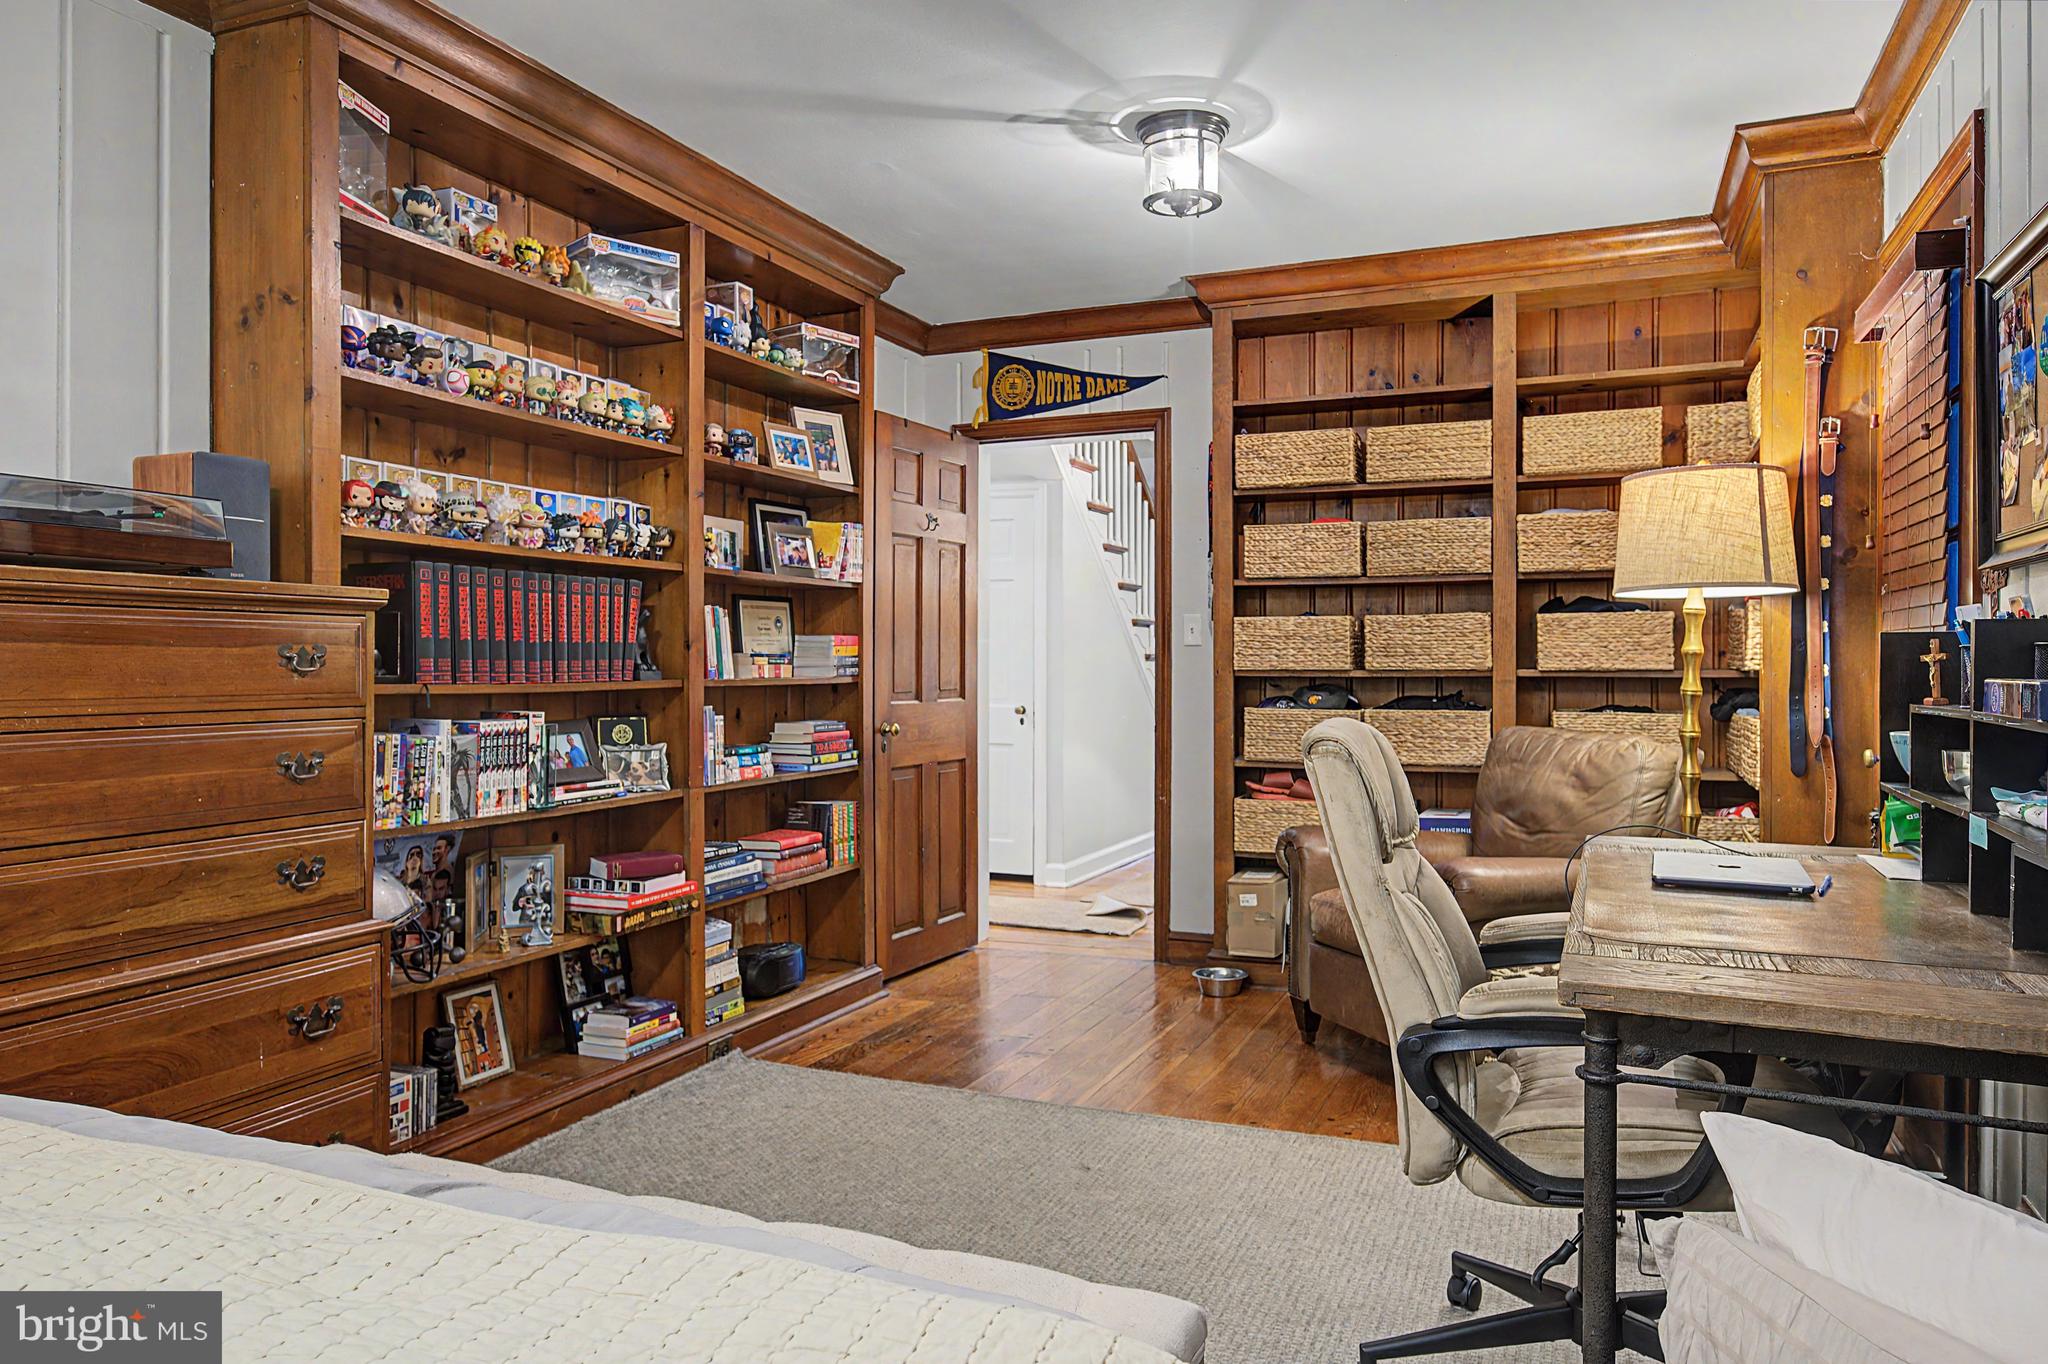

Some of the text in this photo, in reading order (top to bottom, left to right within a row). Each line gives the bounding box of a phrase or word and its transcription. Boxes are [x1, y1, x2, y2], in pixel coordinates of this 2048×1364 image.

[1035, 369, 1082, 406] NOTRE
[1085, 376, 1129, 399] DAME
[420, 582, 432, 638] BERSERK
[438, 584, 450, 639] BERSERK
[476, 587, 487, 641] BERSERK
[1430, 826, 1473, 834] HAMMERMIL
